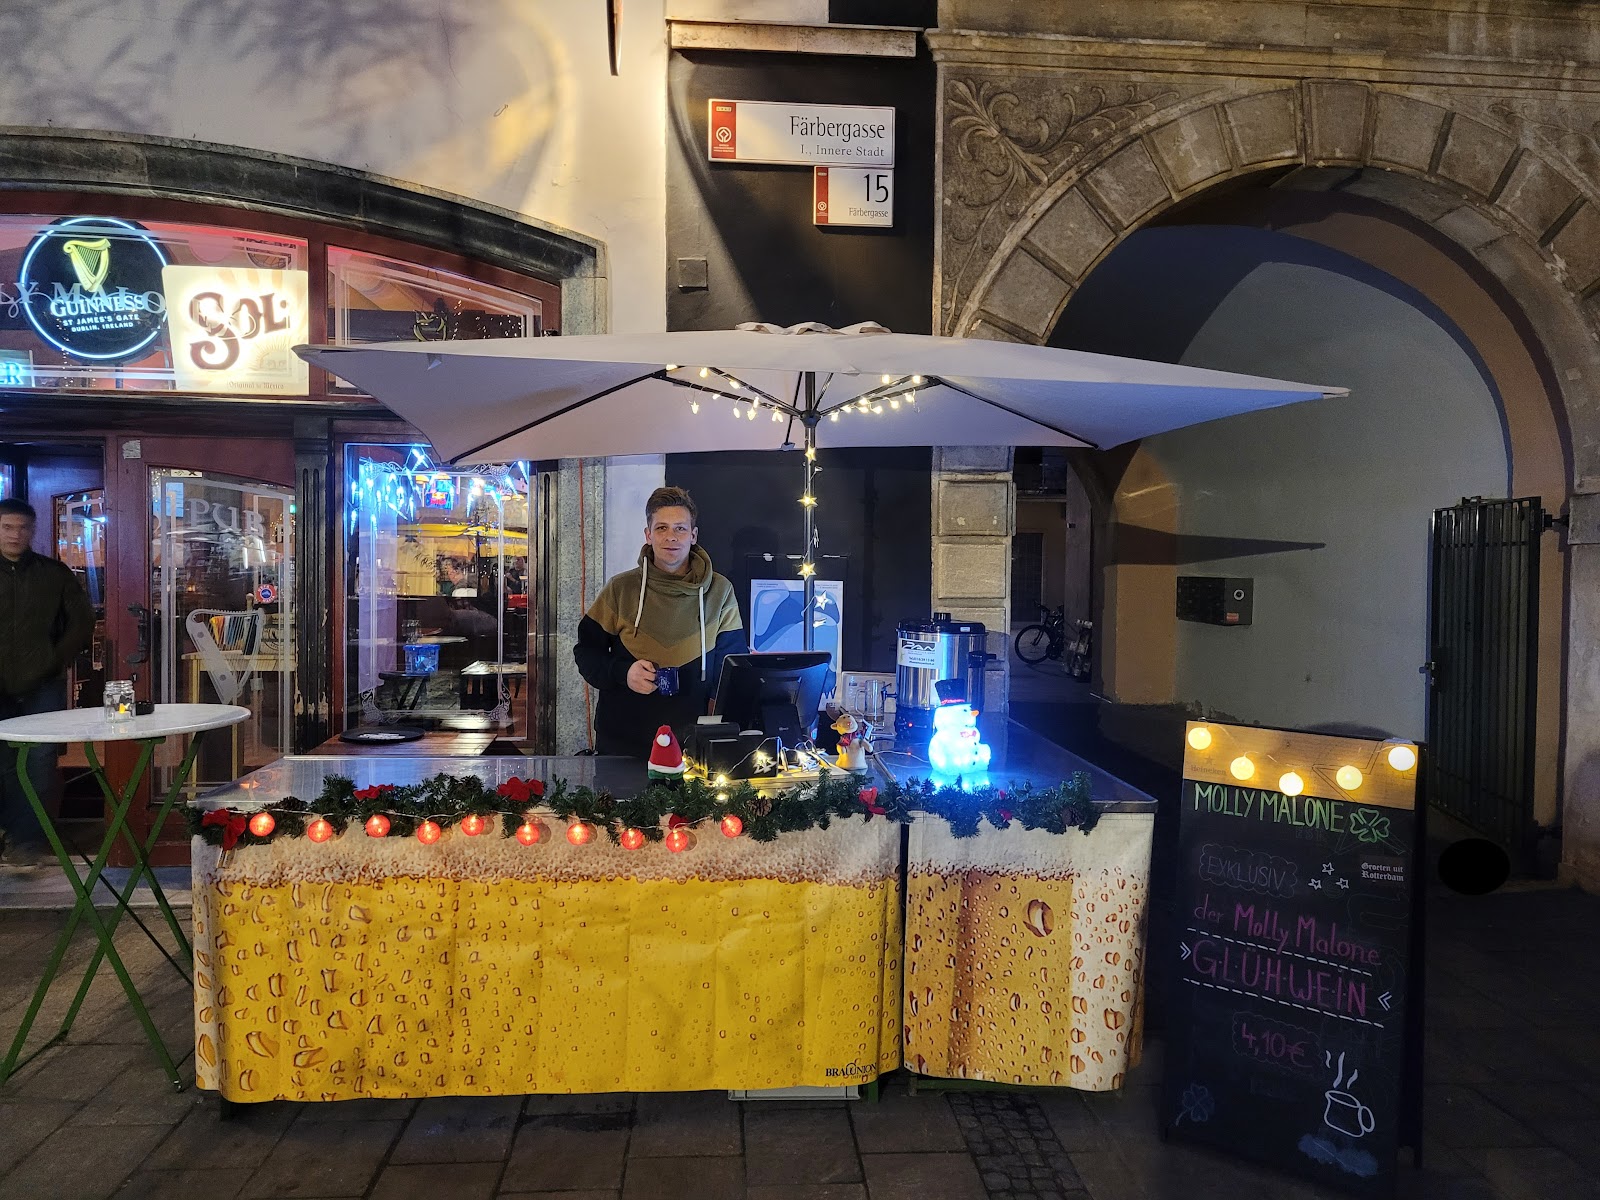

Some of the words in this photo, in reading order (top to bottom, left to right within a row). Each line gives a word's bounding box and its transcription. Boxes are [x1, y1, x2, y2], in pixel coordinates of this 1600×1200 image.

[789, 115, 886, 142] Färbergasse
[816, 145, 852, 156] Innere
[856, 146, 885, 157] Stadt
[863, 173, 889, 203] 15
[848, 207, 889, 219] Färbergasse
[50, 294, 145, 317] GUINNESS
[63, 319, 74, 327] ST
[77, 315, 113, 325] JAMES'S
[116, 313, 140, 322] GATE
[102, 322, 134, 331] IRELAND
[189, 498, 264, 536] PUB
[1190, 765, 1227, 777] Heineken
[1194, 782, 1255, 818] MOLLY
[1259, 790, 1345, 834] MALONE
[1207, 855, 1287, 890] EXKLUSIV
[1361, 862, 1390, 871] Groeten
[1393, 865, 1404, 873] uit
[1361, 870, 1404, 881] Rotterdam
[1194, 894, 1224, 923] der
[1233, 902, 1289, 955] Molly
[1295, 913, 1383, 966] Malone
